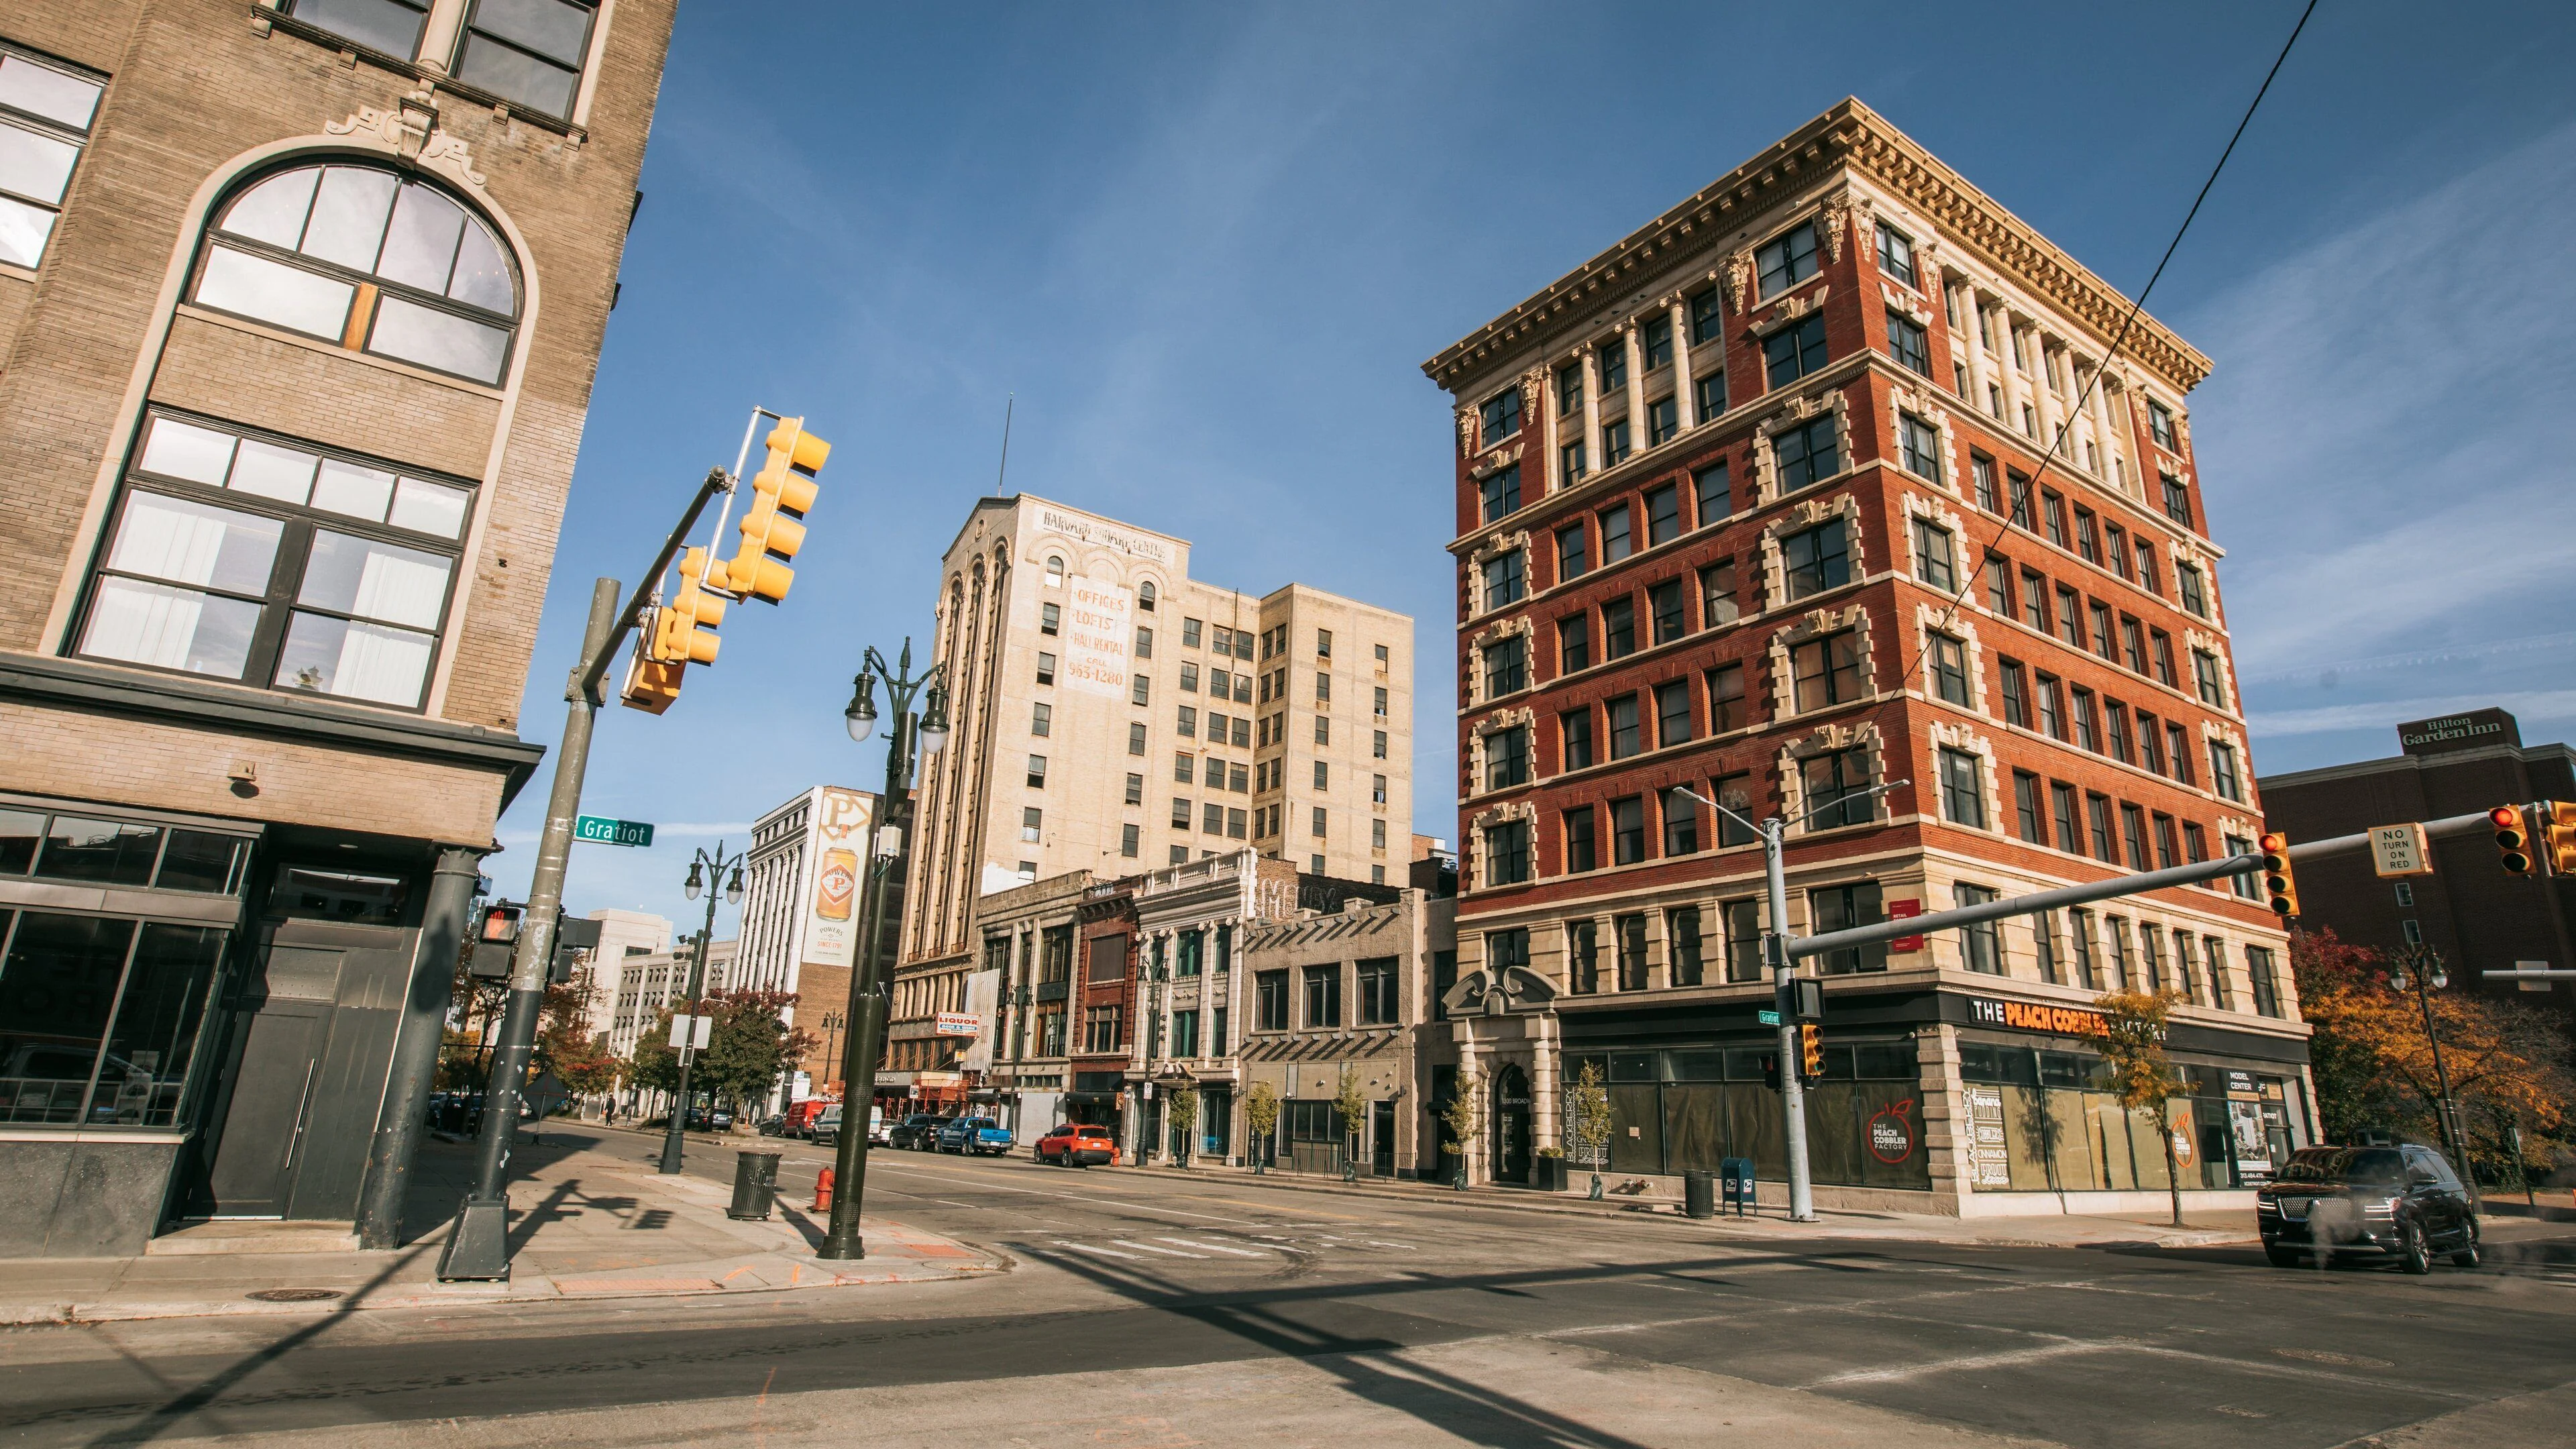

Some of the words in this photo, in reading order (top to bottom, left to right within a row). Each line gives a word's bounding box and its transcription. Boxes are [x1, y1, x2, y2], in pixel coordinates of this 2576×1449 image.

[1078, 589, 1124, 611] OFFICES
[1077, 610, 1111, 630] LOFTS
[1074, 632, 1091, 648] HALL
[1094, 637, 1123, 656] RENTAL
[1069, 662, 1123, 686] 963-1280
[2427, 718, 2472, 731] Hilton
[2402, 729, 2467, 745] Garden
[2467, 722, 2502, 736] Inn
[585, 820, 645, 843] Gratiot
[2383, 830, 2404, 840] NO
[2382, 841, 2409, 850] TURN
[2391, 851, 2405, 859] ON
[2390, 861, 2409, 869] RED
[820, 926, 843, 936] POWERS
[1762, 1014, 1779, 1022] Gratiot
[1974, 1001, 2004, 1022] THE
[2004, 1002, 2052, 1030] PEACH
[2230, 1072, 2249, 1080] MODEL
[2231, 1082, 2251, 1090] CENTER
[1972, 1088, 2001, 1107] banana
[1974, 1107, 2001, 1118] PUDDING
[1566, 1088, 1574, 1162] BLACKBERRY
